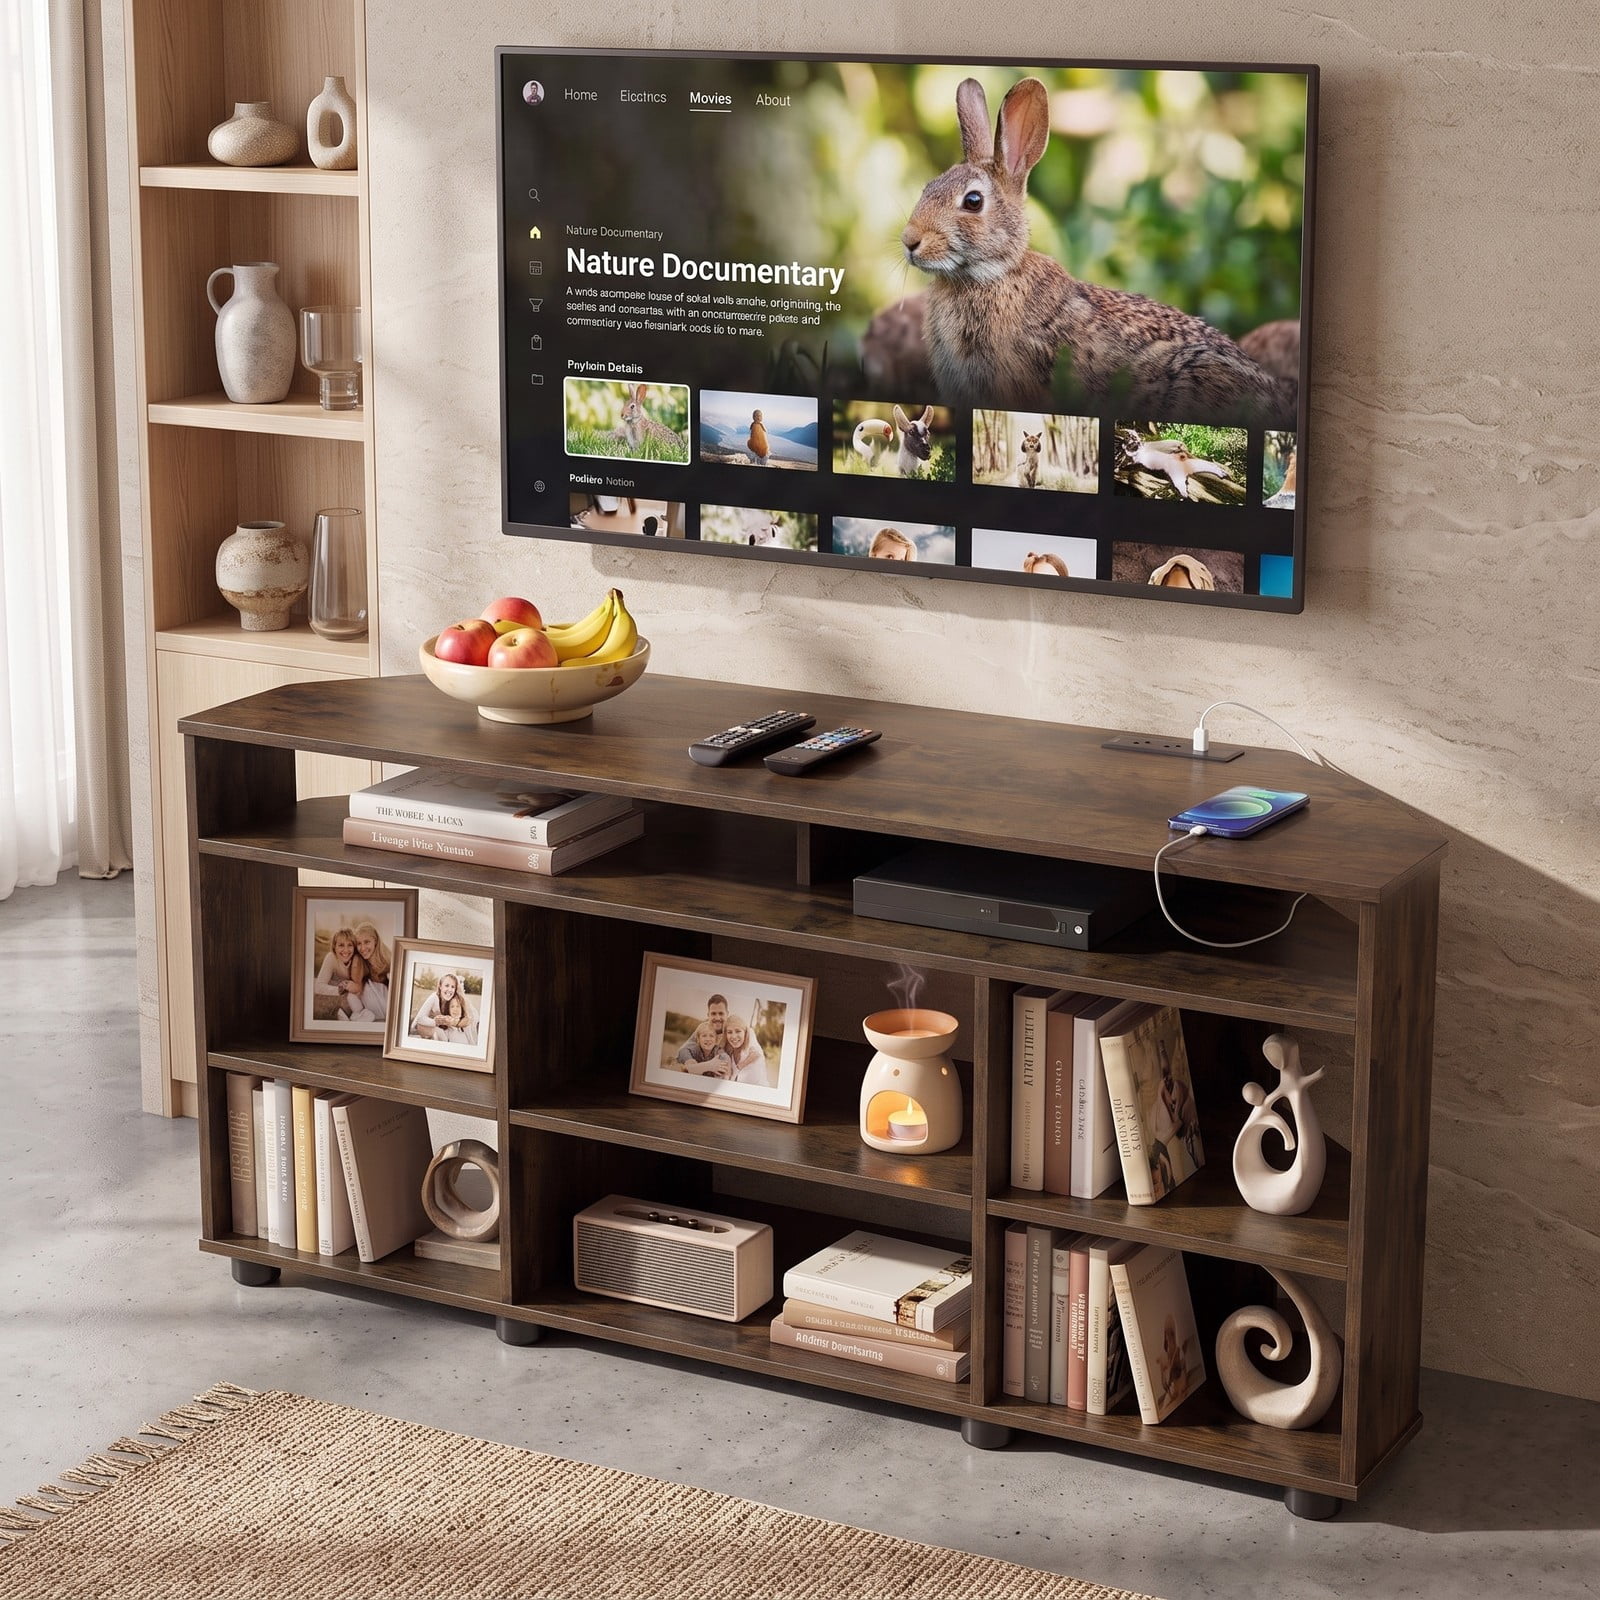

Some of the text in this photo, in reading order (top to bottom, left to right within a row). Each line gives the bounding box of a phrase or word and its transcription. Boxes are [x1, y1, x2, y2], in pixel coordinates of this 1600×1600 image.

[564, 88, 598, 102] Home
[689, 91, 732, 106] Movies
[755, 93, 791, 107] About
[566, 225, 663, 242] Nature Documentary
[566, 247, 845, 294] Nature Documentary
[566, 286, 573, 295] A
[674, 292, 684, 302] of
[825, 301, 841, 312] the
[598, 303, 616, 313] and
[666, 306, 686, 317] with
[687, 309, 700, 318] an
[801, 315, 820, 326] and
[727, 325, 737, 335] to
[739, 327, 765, 337] mare.
[605, 476, 635, 488] Notion
[376, 806, 394, 817] THE
